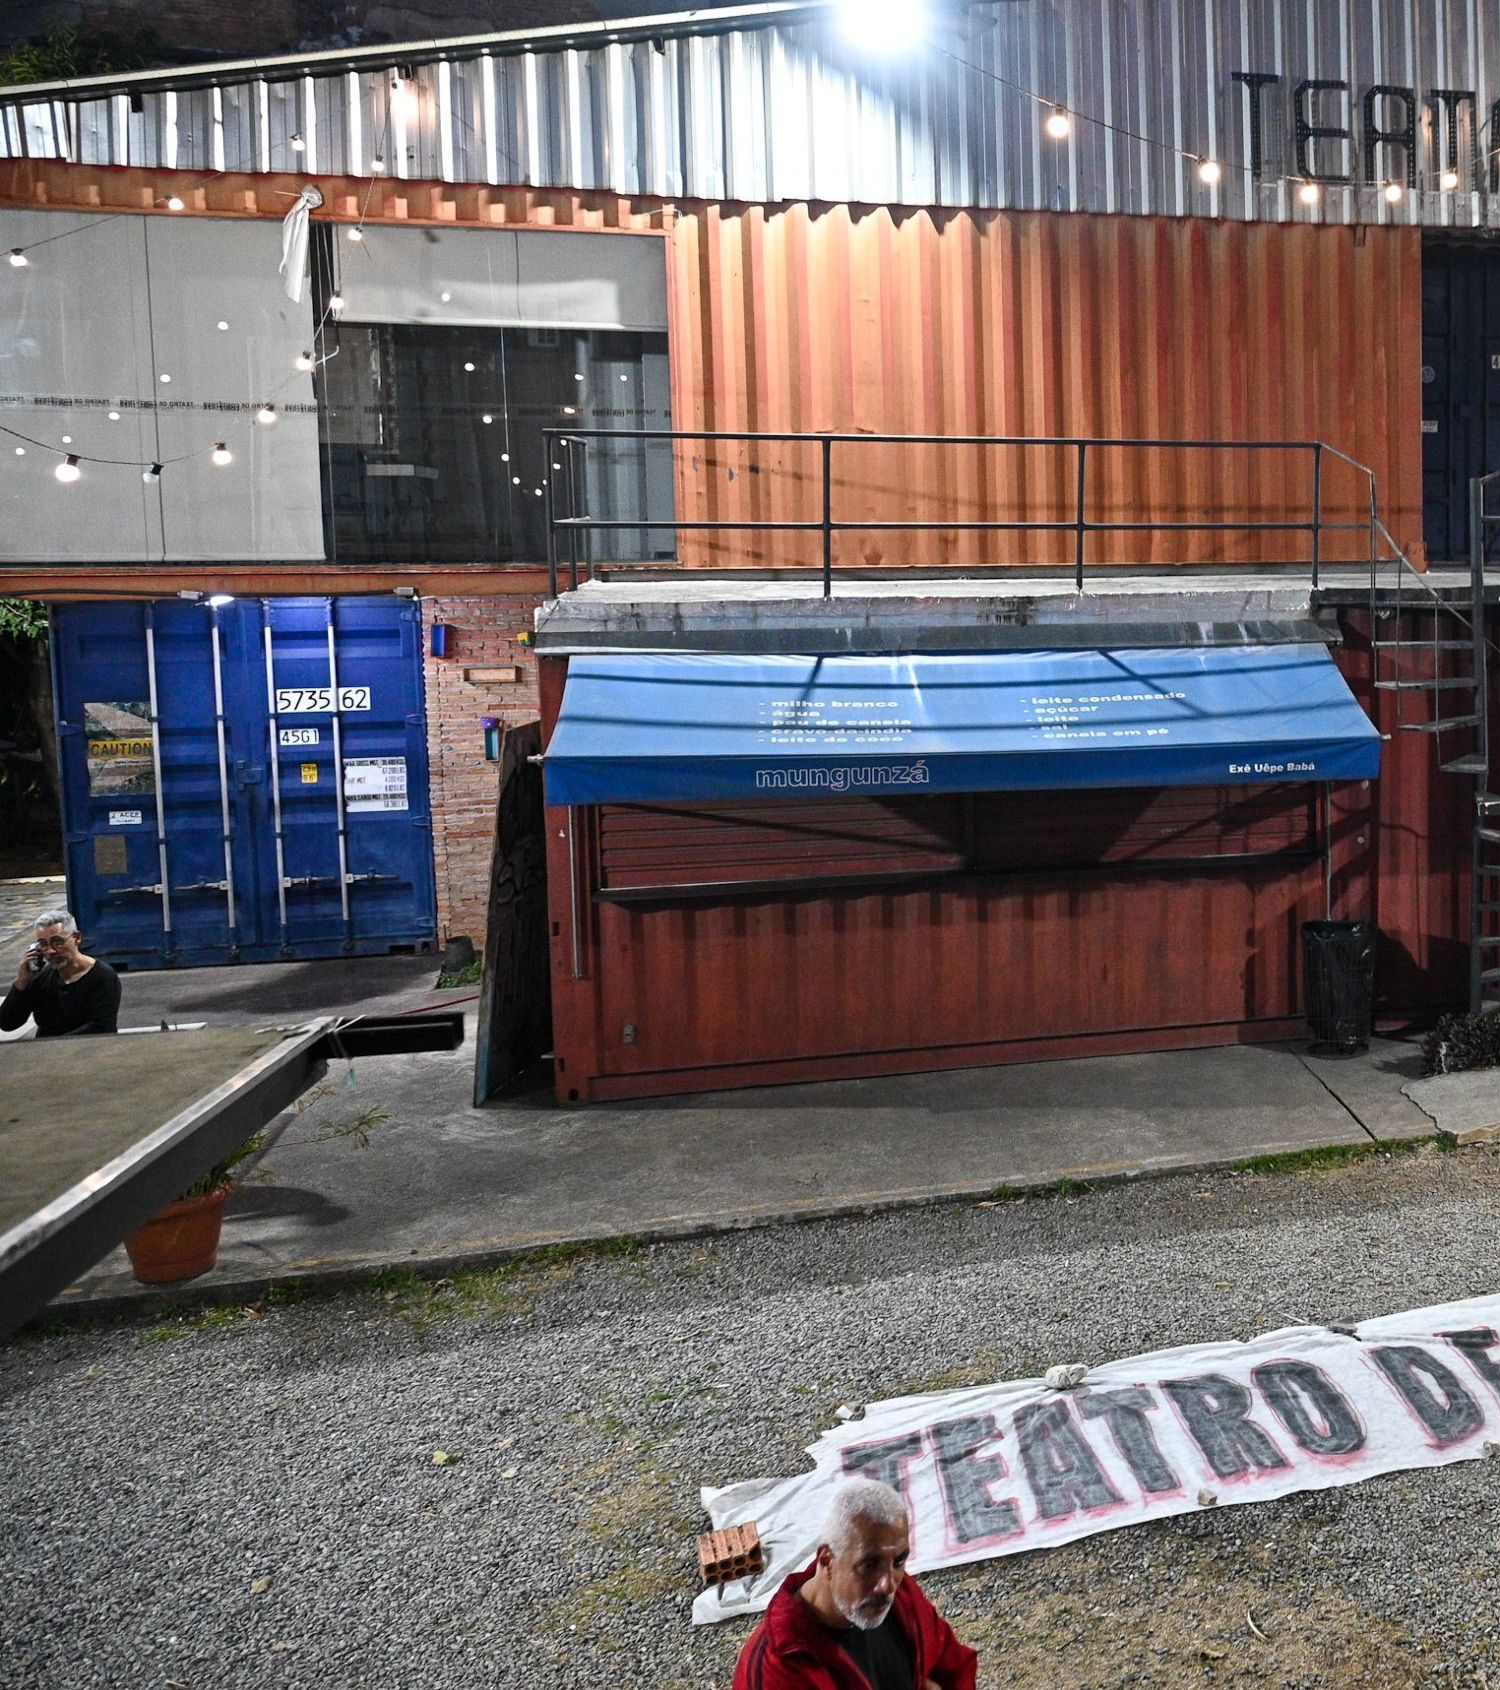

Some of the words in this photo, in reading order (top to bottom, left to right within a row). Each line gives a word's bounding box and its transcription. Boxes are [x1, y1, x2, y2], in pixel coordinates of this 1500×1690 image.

[1031, 697, 1073, 705] leite
[1078, 692, 1186, 704] condensado
[771, 700, 826, 708] milho
[831, 700, 898, 708] branco
[1034, 705, 1099, 714] açúcar
[772, 719, 809, 727] pau
[815, 718, 840, 726] de
[846, 718, 912, 726] canela
[1037, 715, 1080, 723] leite
[281, 729, 318, 744] 45G1
[1043, 730, 1107, 739] canela
[770, 736, 817, 744] leite
[90, 741, 153, 758] CAUTION
[1228, 763, 1252, 774] Exê
[1286, 761, 1315, 772] Babá
[755, 759, 931, 792] mungunzá
